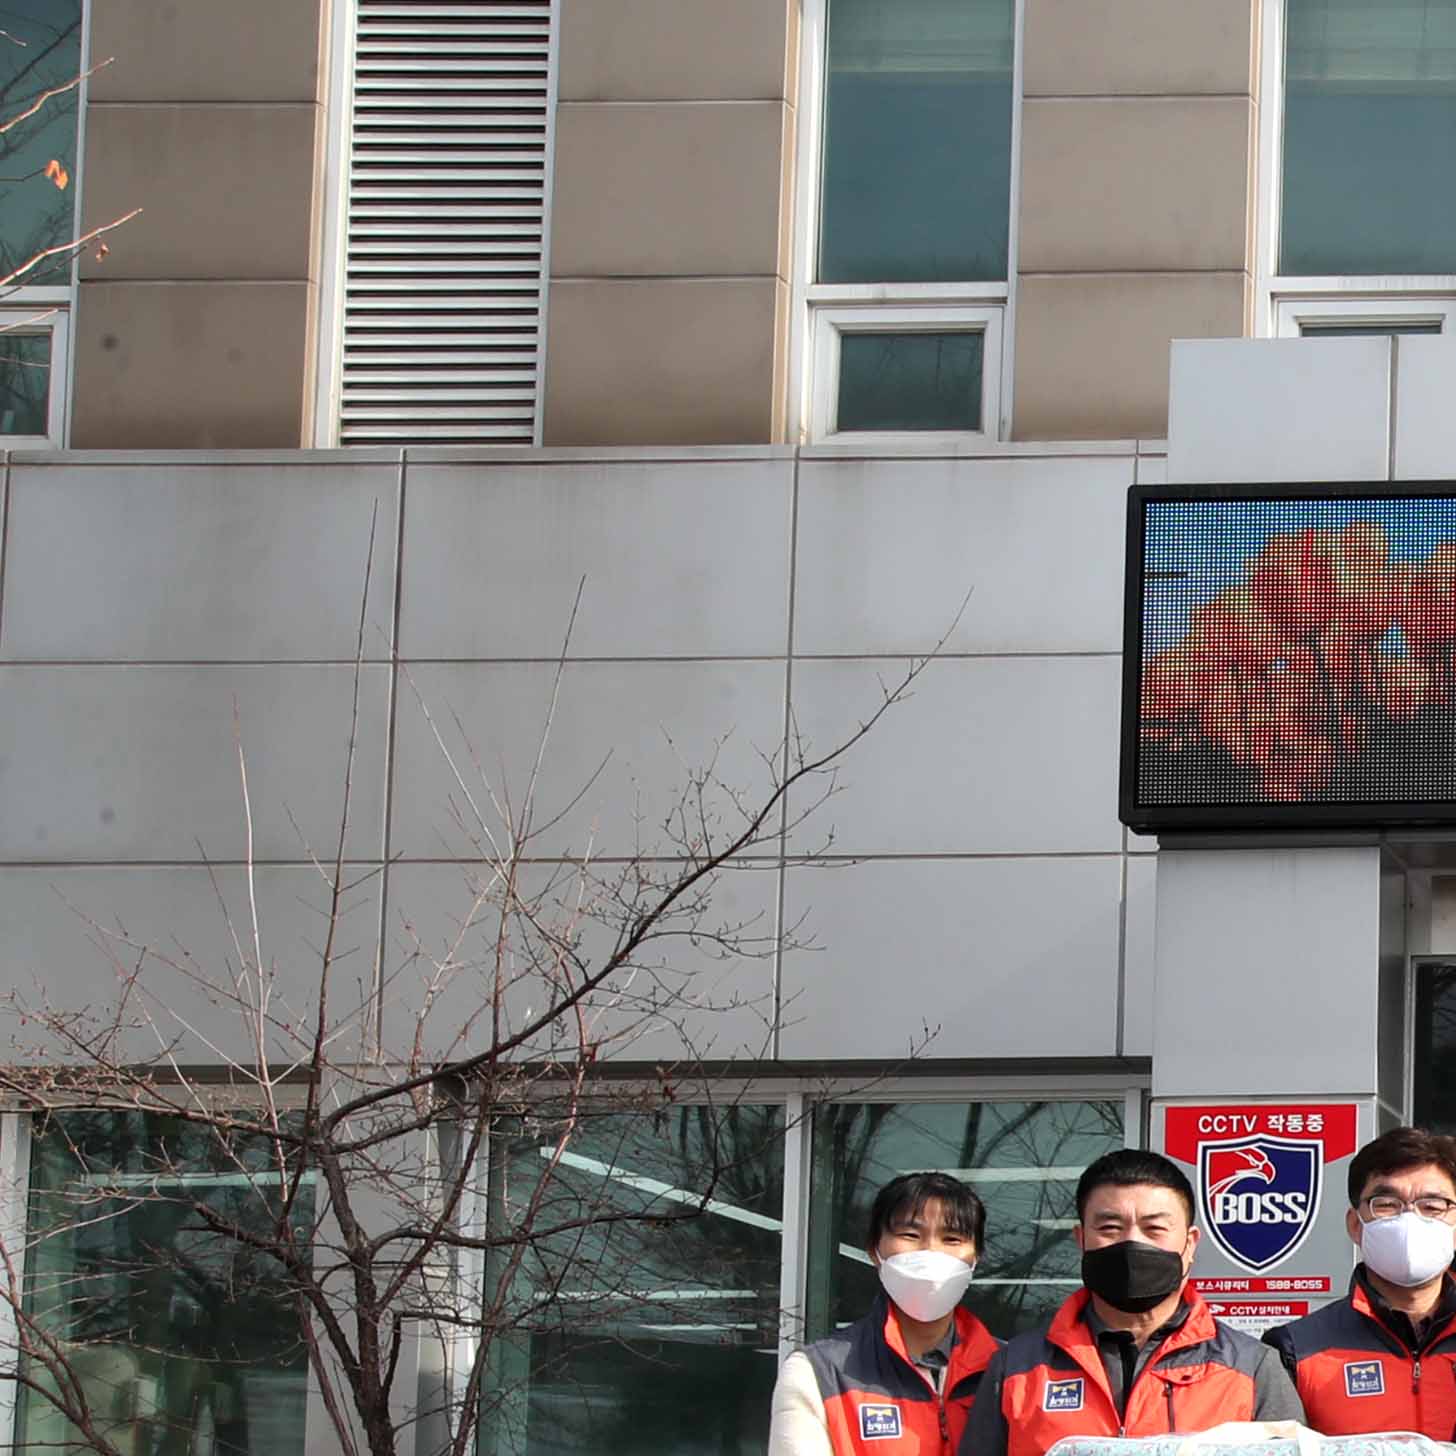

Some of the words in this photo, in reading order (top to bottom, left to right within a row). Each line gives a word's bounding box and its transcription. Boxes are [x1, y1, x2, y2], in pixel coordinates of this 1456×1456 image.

[1198, 1115, 1257, 1133] CCTV
[1267, 1114, 1324, 1132] 작동중
[1215, 1192, 1306, 1224] BOSS
